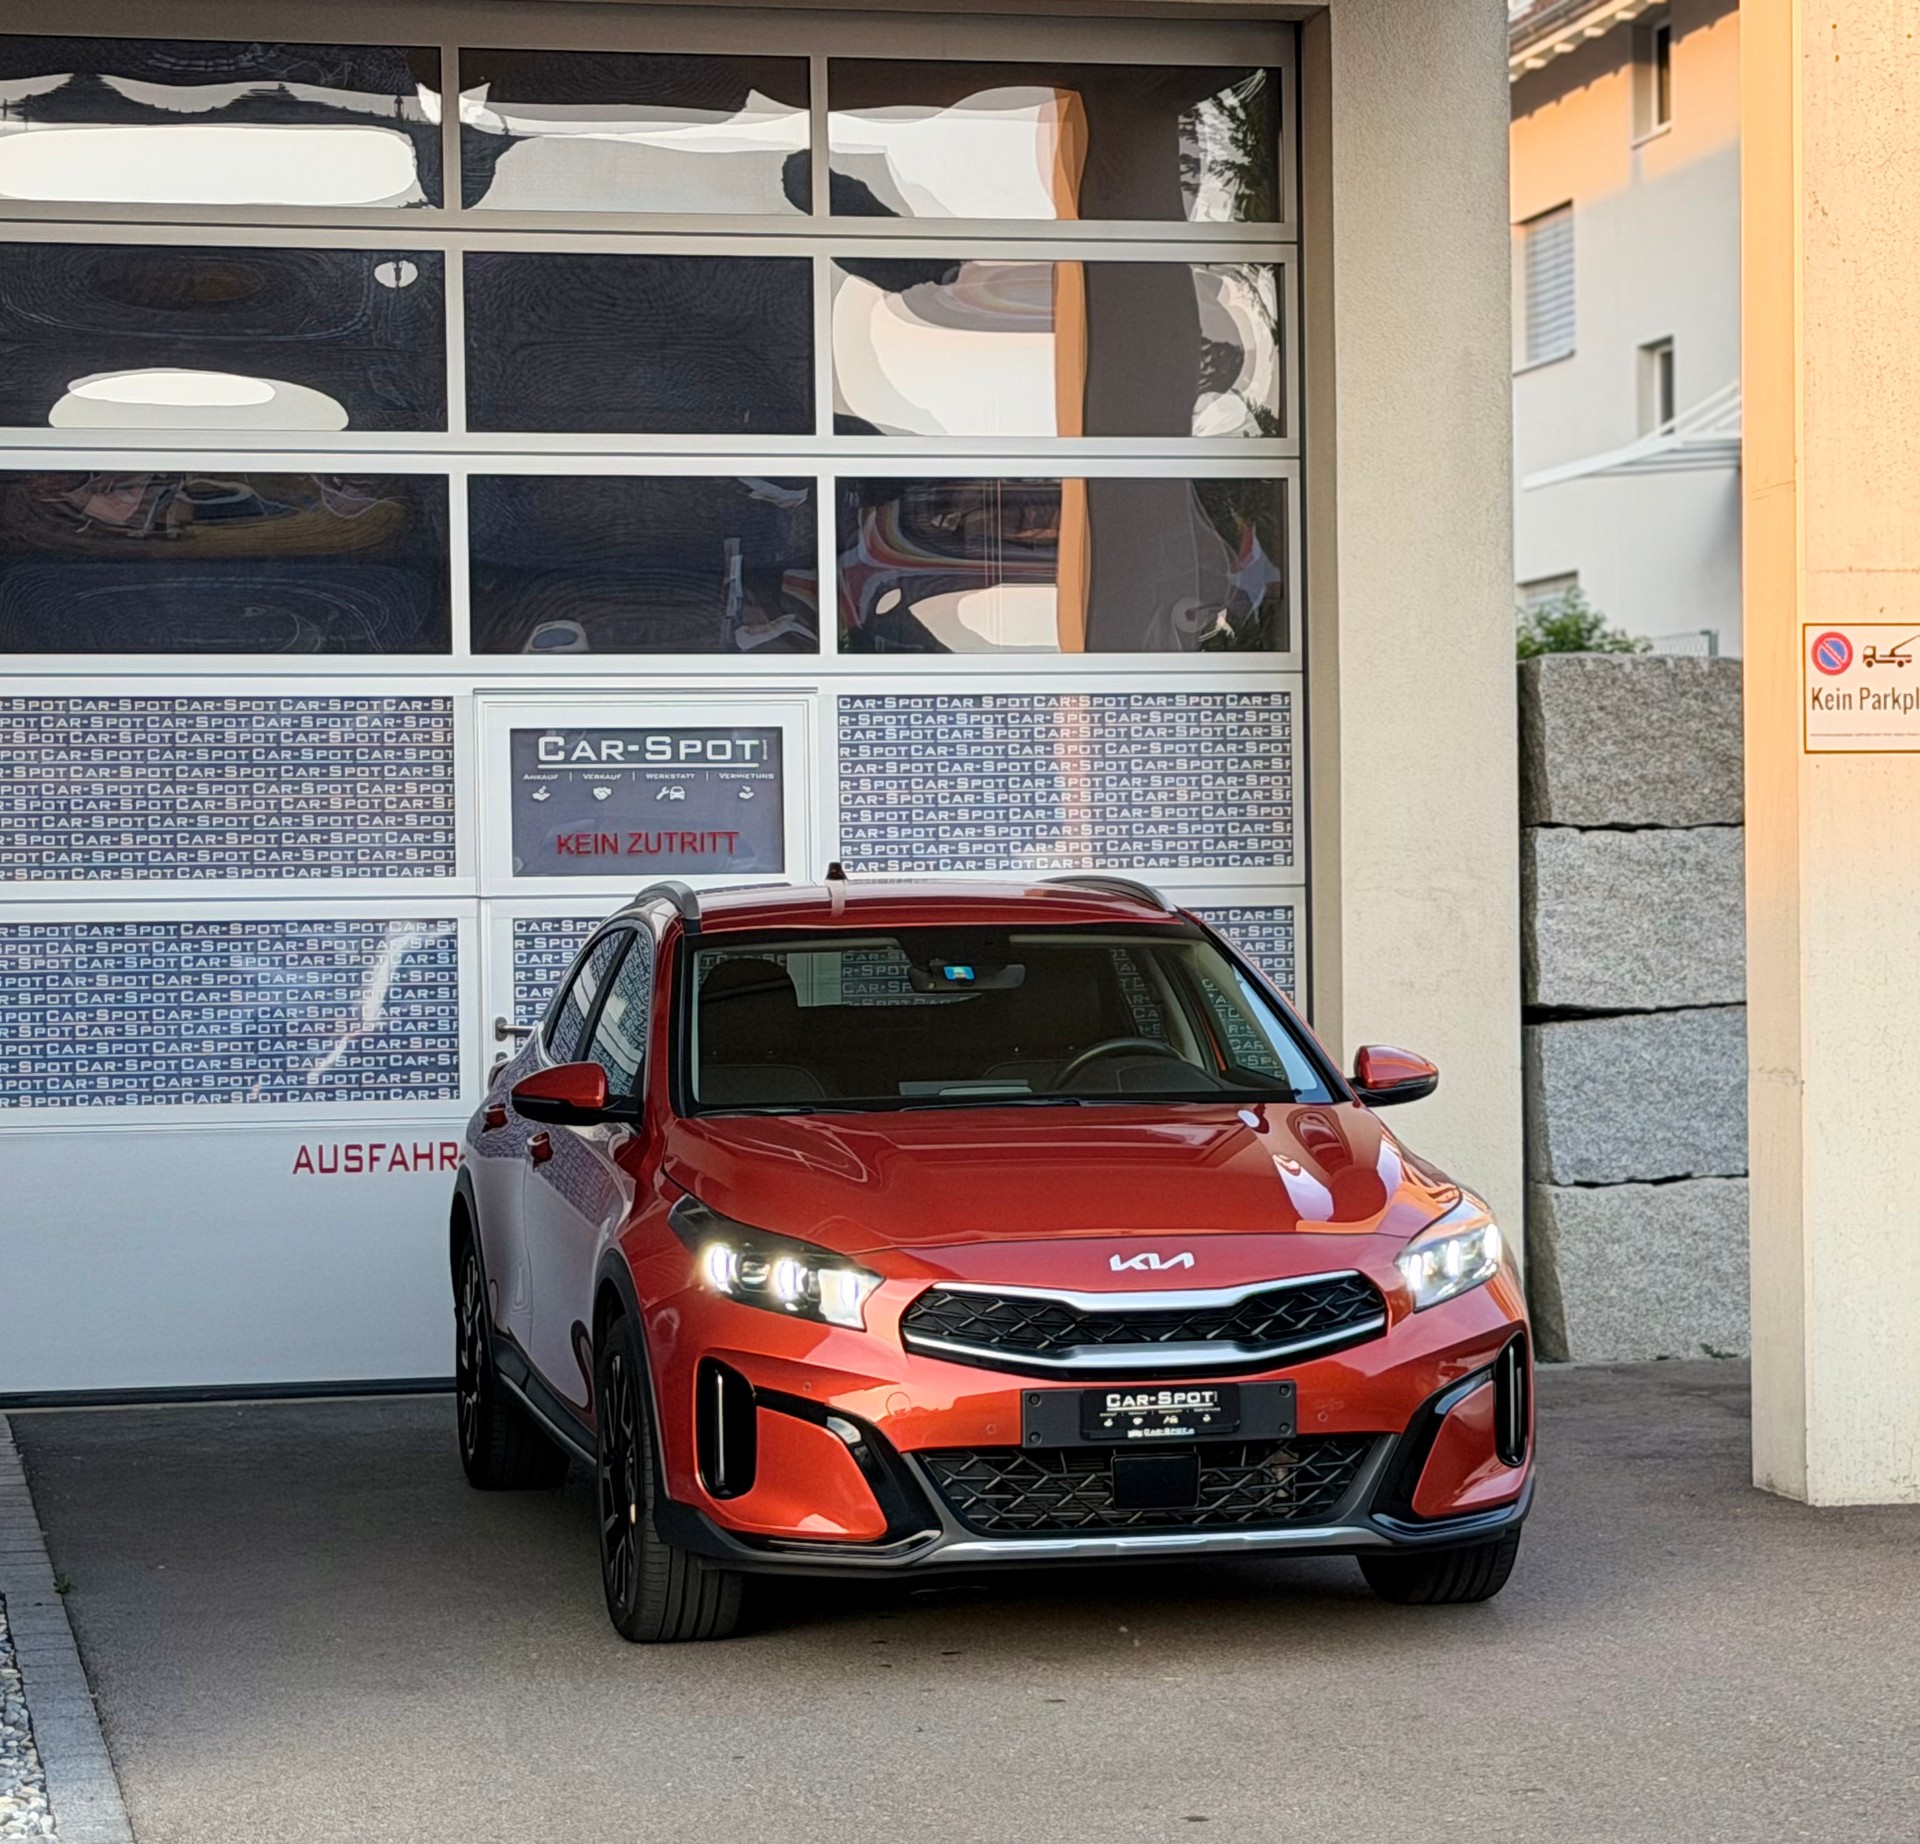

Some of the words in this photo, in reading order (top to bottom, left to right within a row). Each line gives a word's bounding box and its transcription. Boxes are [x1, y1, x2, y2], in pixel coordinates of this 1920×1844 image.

[69, 699, 173, 712] CAR-SPOT
[175, 699, 277, 712] CAR-SPOT
[280, 699, 381, 712] CAR-SPOT
[839, 697, 933, 708] CAR-SPOT
[937, 696, 1031, 708] CARSPOT
[1034, 695, 1127, 707] CAR-SPOT
[1131, 695, 1223, 706] CAR-SPOT
[1811, 686, 1853, 711] Kein
[41, 716, 144, 728] CAR-SPOT
[147, 716, 249, 728] CAR-SPOT
[253, 716, 353, 728] CAR-SPOT
[911, 713, 1005, 724] CAR-SPOT
[1008, 712, 1102, 724] CAR-SPOT
[1105, 711, 1198, 723] CAR-SPOT
[69, 731, 173, 744] CAR-SPOT
[175, 731, 277, 744] CAR-SPOT
[281, 731, 381, 744] CAR-SPOT
[840, 729, 934, 740] CAR-SPOT
[937, 728, 1031, 739] CAR-SPOT
[1034, 727, 1127, 738] CAR-SPOT
[1131, 726, 1224, 738] CAR-SPOT
[41, 748, 145, 761] CAR-SPOT
[147, 748, 249, 761] CAR-SPOT
[253, 748, 353, 761] CAR-SPOT
[538, 736, 760, 761] CAR-SPOT
[911, 744, 1005, 756] CAR-SPOT
[1008, 743, 1102, 755] CAR-SPOT
[70, 766, 174, 778] CAR-SPOT
[176, 765, 278, 778] CAR-SPOT
[281, 765, 381, 778] CAR-SPOT
[840, 762, 934, 773] CAR-SPOT
[937, 761, 1031, 772] CAR-SPOT
[1035, 760, 1127, 771] CAR-SPOT
[1131, 759, 1224, 770] CAR-SPOT
[41, 783, 145, 796] CAR-SPOT
[148, 783, 250, 796] CAR-SPOT
[253, 782, 354, 795] CAR-SPOT
[911, 778, 1005, 789] CAR-SPOT
[1008, 776, 1102, 788] CAR-SPOT
[1106, 775, 1198, 787] CAR-SPOT
[70, 798, 174, 811] CAR-SPOT
[176, 798, 278, 811] CAR-SPOT
[281, 797, 382, 810] CAR-SPOT
[841, 793, 935, 805] CAR-SPOT
[938, 792, 1032, 804] CAR-SPOT
[1035, 791, 1128, 802] CAR-SPOT
[1132, 790, 1224, 801] CAR-SPOT
[912, 809, 1006, 820] CAR-SPOT
[1009, 807, 1103, 819] CAR-SPOT
[1106, 806, 1199, 818] CAR-SPOT
[42, 815, 146, 828] CAR-SPOT
[148, 815, 250, 828] CAR-SPOT
[254, 814, 354, 827] CAR-SPOT
[841, 827, 935, 838] CAR-SPOT
[939, 825, 1033, 837] CAR-SPOT
[1036, 824, 1129, 836] CAR-SPOT
[1133, 823, 1225, 834] CAR-SPOT
[71, 833, 174, 846] CAR-SPOT
[177, 832, 279, 845] CAR-SPOT
[282, 831, 382, 844] CAR-SPOT
[556, 833, 619, 855] KEIN
[627, 831, 740, 855] ZUTRITT
[913, 842, 1007, 854] CAR-SPOT
[1010, 841, 1104, 852] CAR-SPOT
[1107, 839, 1200, 851] CAR-SPOT
[42, 850, 146, 863] CAR-SPOT
[148, 849, 250, 862] CAR-SPOT
[254, 849, 354, 862] CAR-SPOT
[842, 860, 936, 871] CAR-SPOT
[940, 858, 1034, 870] CAR-SPOT
[1037, 857, 1130, 868] CAR-SPOT
[1133, 855, 1226, 867] CAR-SPOT
[71, 867, 175, 880] CAR-SPOT
[177, 866, 279, 879] CAR-SPOT
[282, 865, 383, 878] CAR-SPOT
[75, 924, 177, 937] CAR-SPOT
[181, 923, 282, 936] CAR-SPOT
[286, 921, 385, 934] CAR-SPOT
[46, 941, 149, 954] CAR-SPOT
[152, 940, 253, 953] CAR-SPOT
[257, 938, 358, 951] CAR-SPOT
[75, 957, 178, 970] CAR-SPOT
[181, 955, 282, 968] CAR-SPOT
[46, 974, 149, 987] CAR-SPOT
[153, 973, 254, 986] CAR-SPOT
[258, 971, 358, 984] CAR-SPOT
[75, 991, 178, 1004] CAR-SPOT
[181, 990, 282, 1002] CAR-SPOT
[46, 1009, 149, 1022] CAR-SPOT
[153, 1007, 254, 1020] CAR-SPOT
[258, 1006, 358, 1018] CAR-SPOT
[75, 1024, 178, 1037] CAR-SPOT
[181, 1022, 282, 1035] CAR-SPOT
[47, 1042, 149, 1054] CAR-SPOT
[153, 1040, 254, 1053] CAR-SPOT
[76, 1059, 178, 1072] CAR-SPOT
[181, 1057, 282, 1070] CAR-SPOT
[47, 1077, 150, 1090] CAR-SPOT
[153, 1075, 254, 1088] CAR-SPOT
[259, 1073, 358, 1086] CAR-SPOT
[76, 1093, 179, 1106] CAR-SPOT
[182, 1091, 283, 1104] CAR-SPOT
[287, 1089, 386, 1102] CAR-SPOT
[1106, 1391, 1214, 1408] CAR-SPOT
